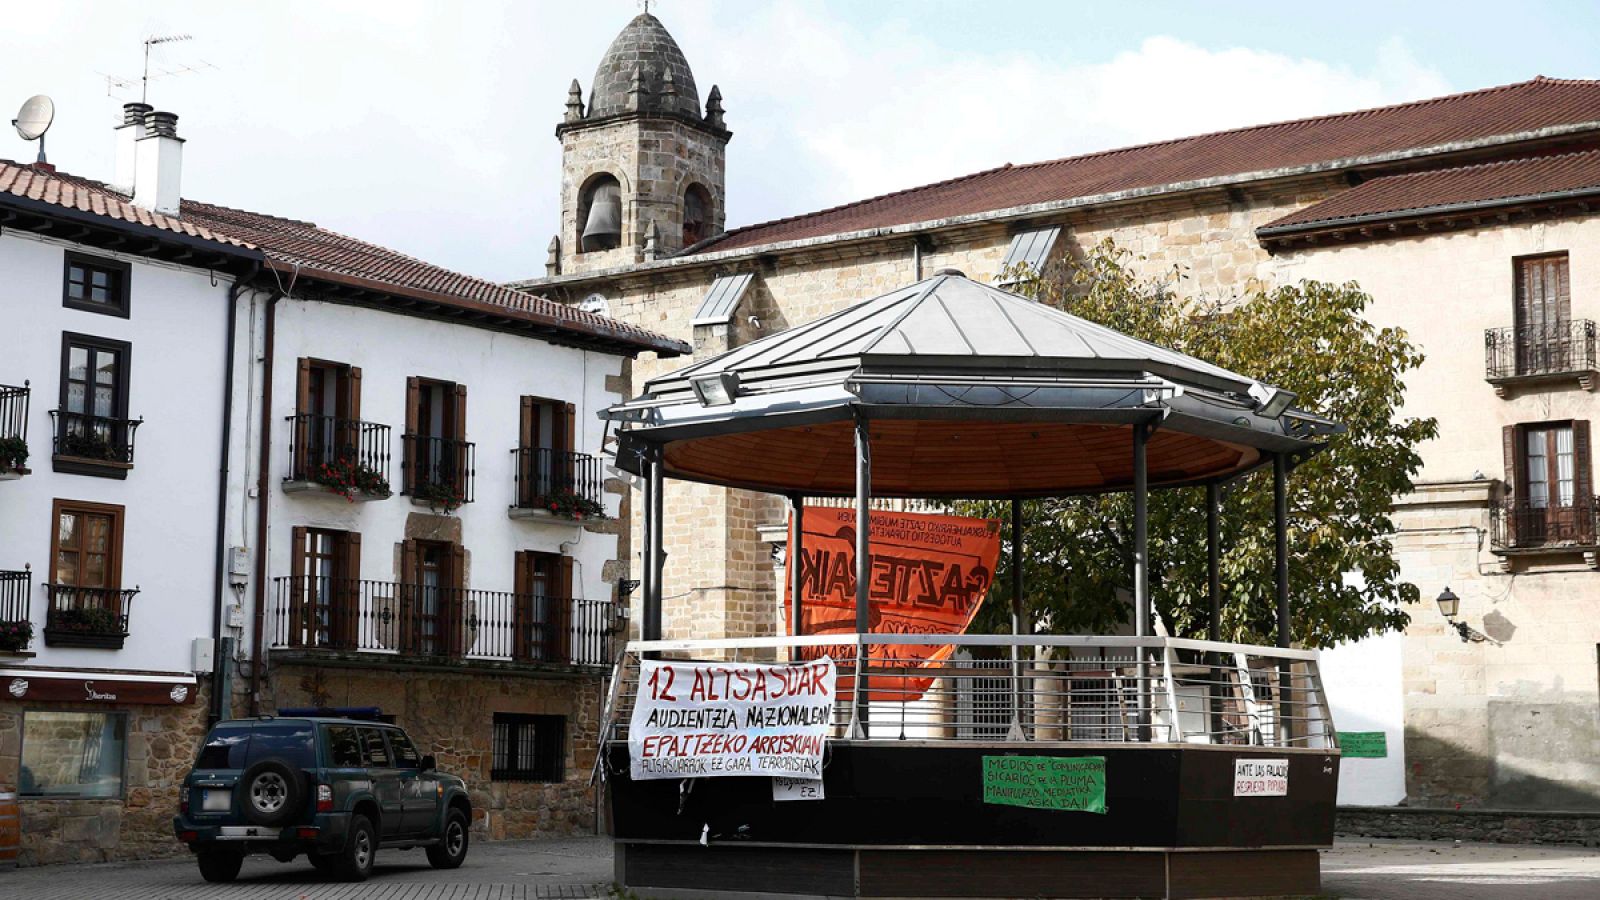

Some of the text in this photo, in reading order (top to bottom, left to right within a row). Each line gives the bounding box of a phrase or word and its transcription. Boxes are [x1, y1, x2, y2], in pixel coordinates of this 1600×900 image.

[648, 664, 829, 702] 12 ALTSASUAR
[646, 703, 832, 730] AUDIENTZIA NAZIONALEAN
[642, 734, 824, 758] EPAITZEKO ARRISKUAN
[711, 757, 723, 770] EZ
[726, 757, 751, 771] GARA
[758, 756, 820, 775] TERRORISTAK
[988, 759, 1033, 773] MEDIOS
[1237, 764, 1253, 776] ANTE
[1255, 764, 1265, 777] LAS
[987, 770, 1037, 786] SICARIOS
[1060, 774, 1097, 787] PLUMA
